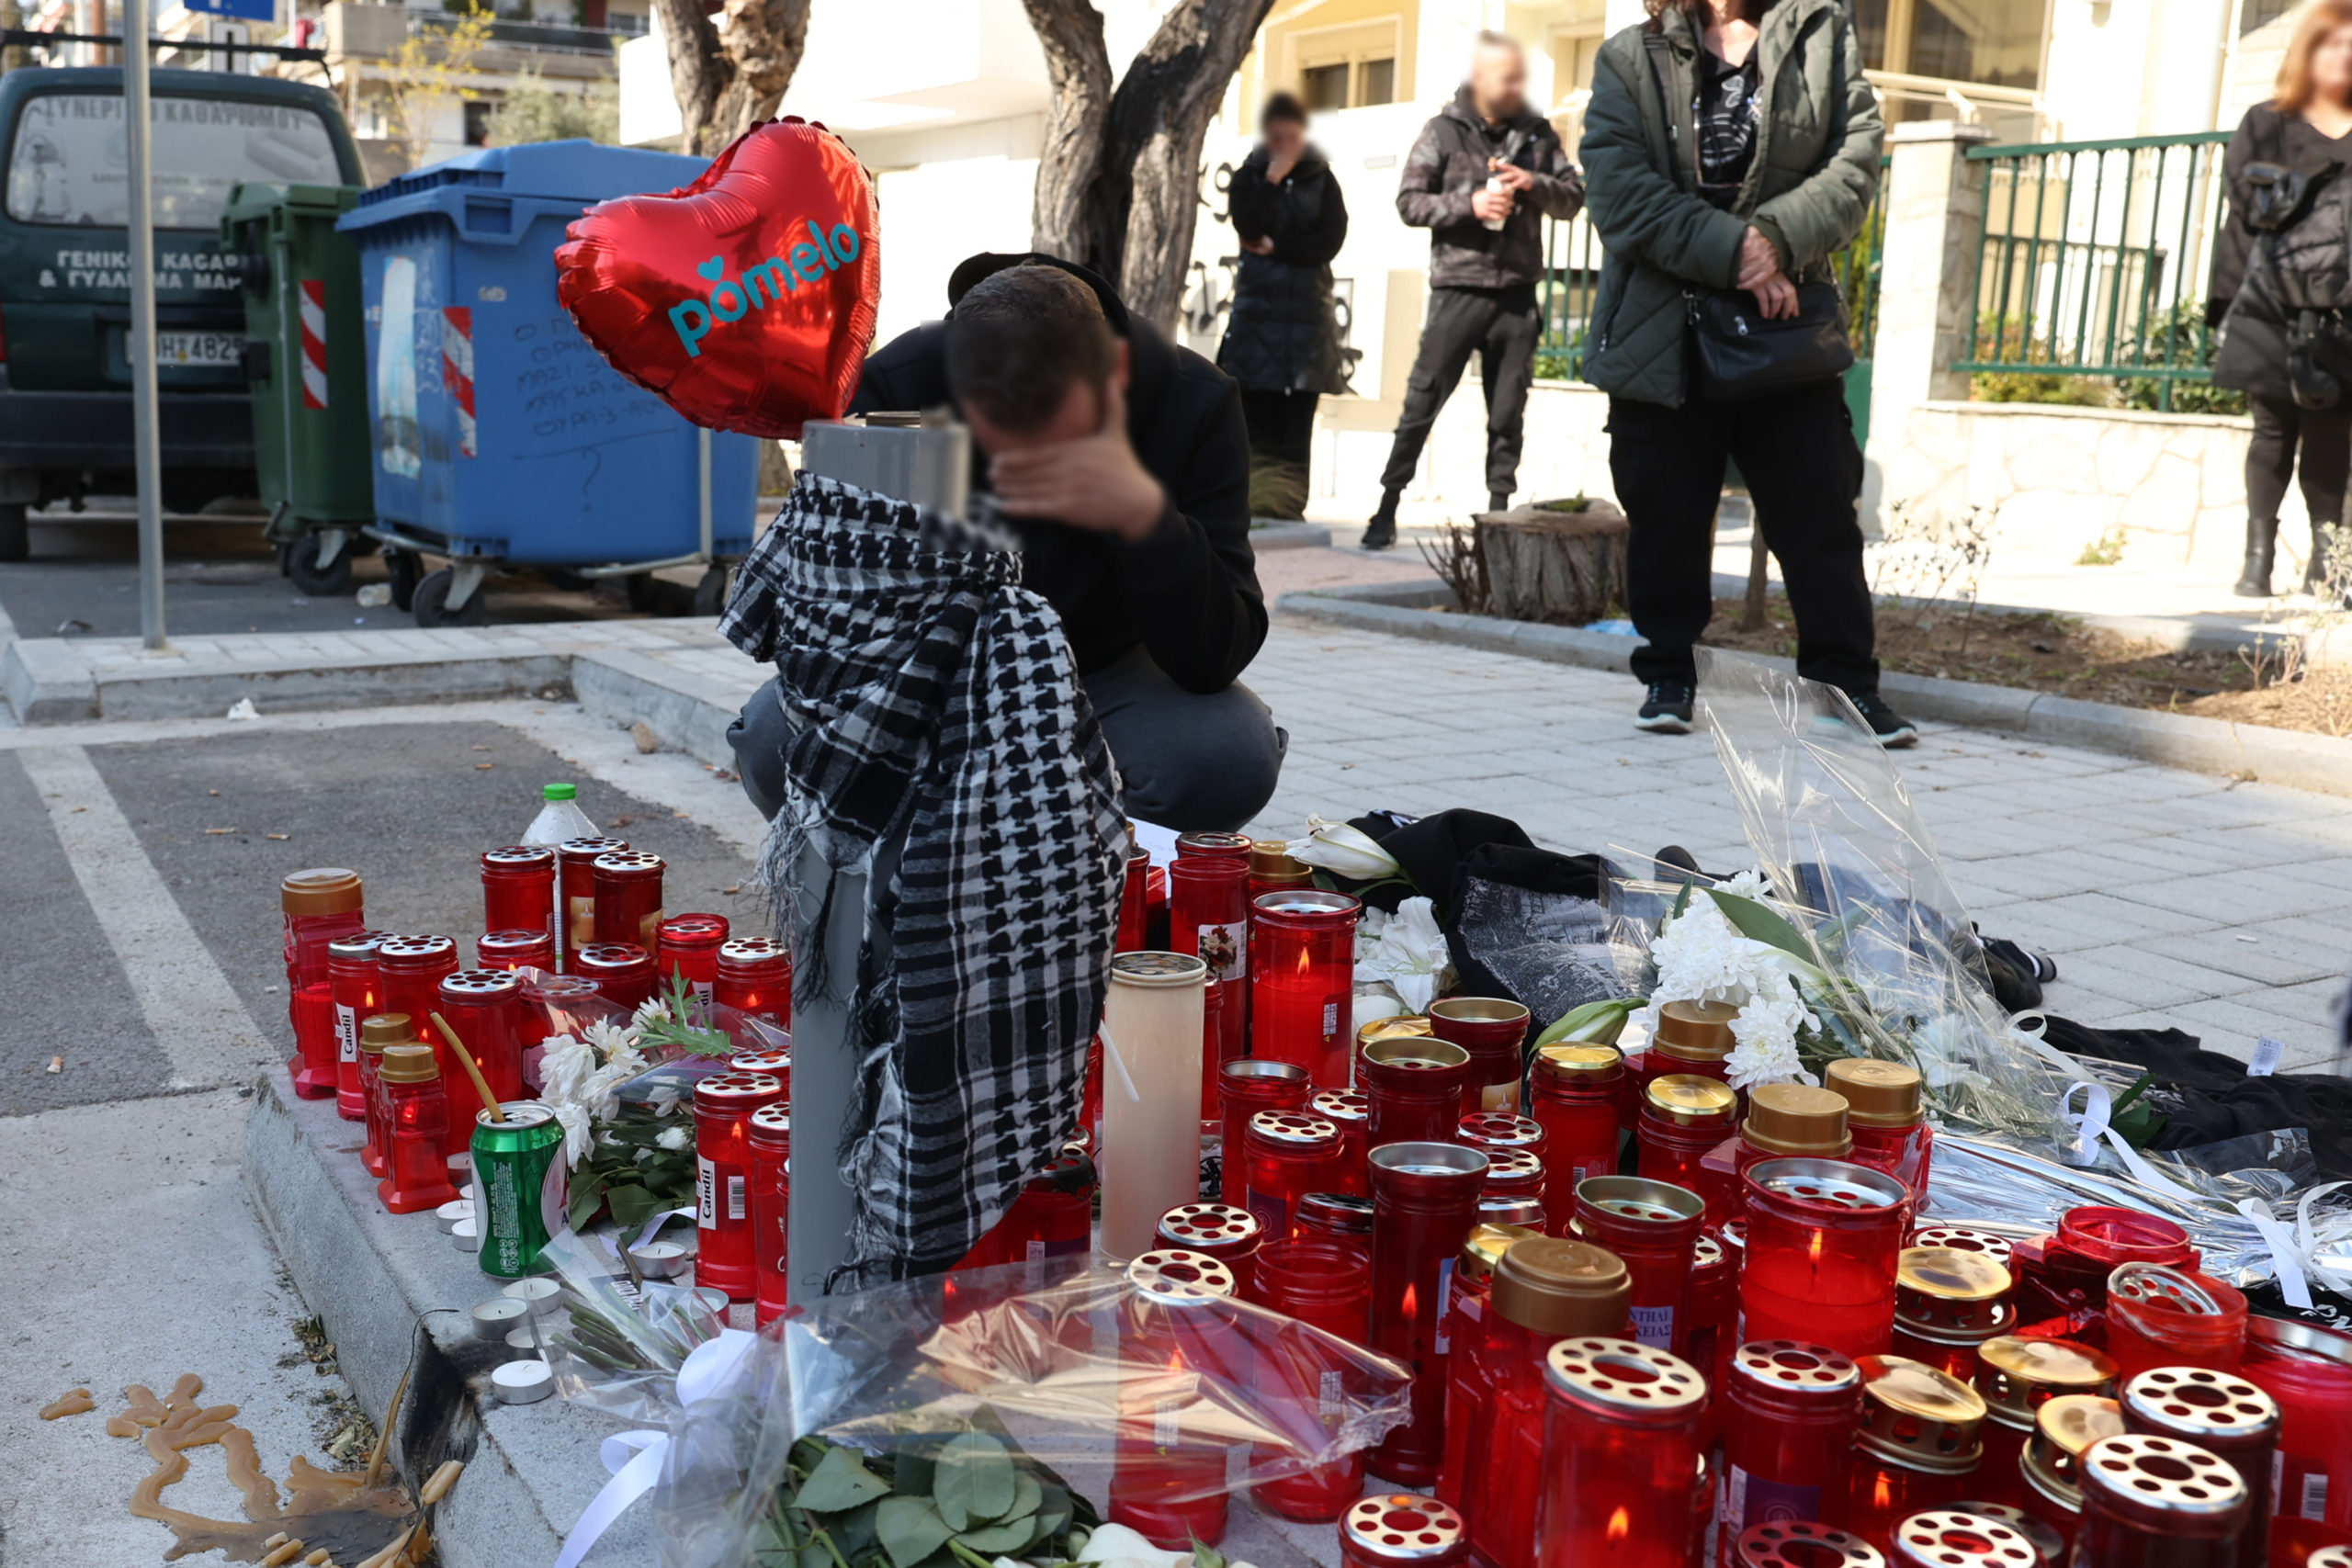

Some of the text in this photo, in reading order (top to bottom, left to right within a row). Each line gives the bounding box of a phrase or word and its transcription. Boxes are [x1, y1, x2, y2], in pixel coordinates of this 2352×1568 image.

[668, 220, 860, 358] pomelo
[341, 1014, 353, 1055] Candil
[701, 1168, 712, 1220] Candil
